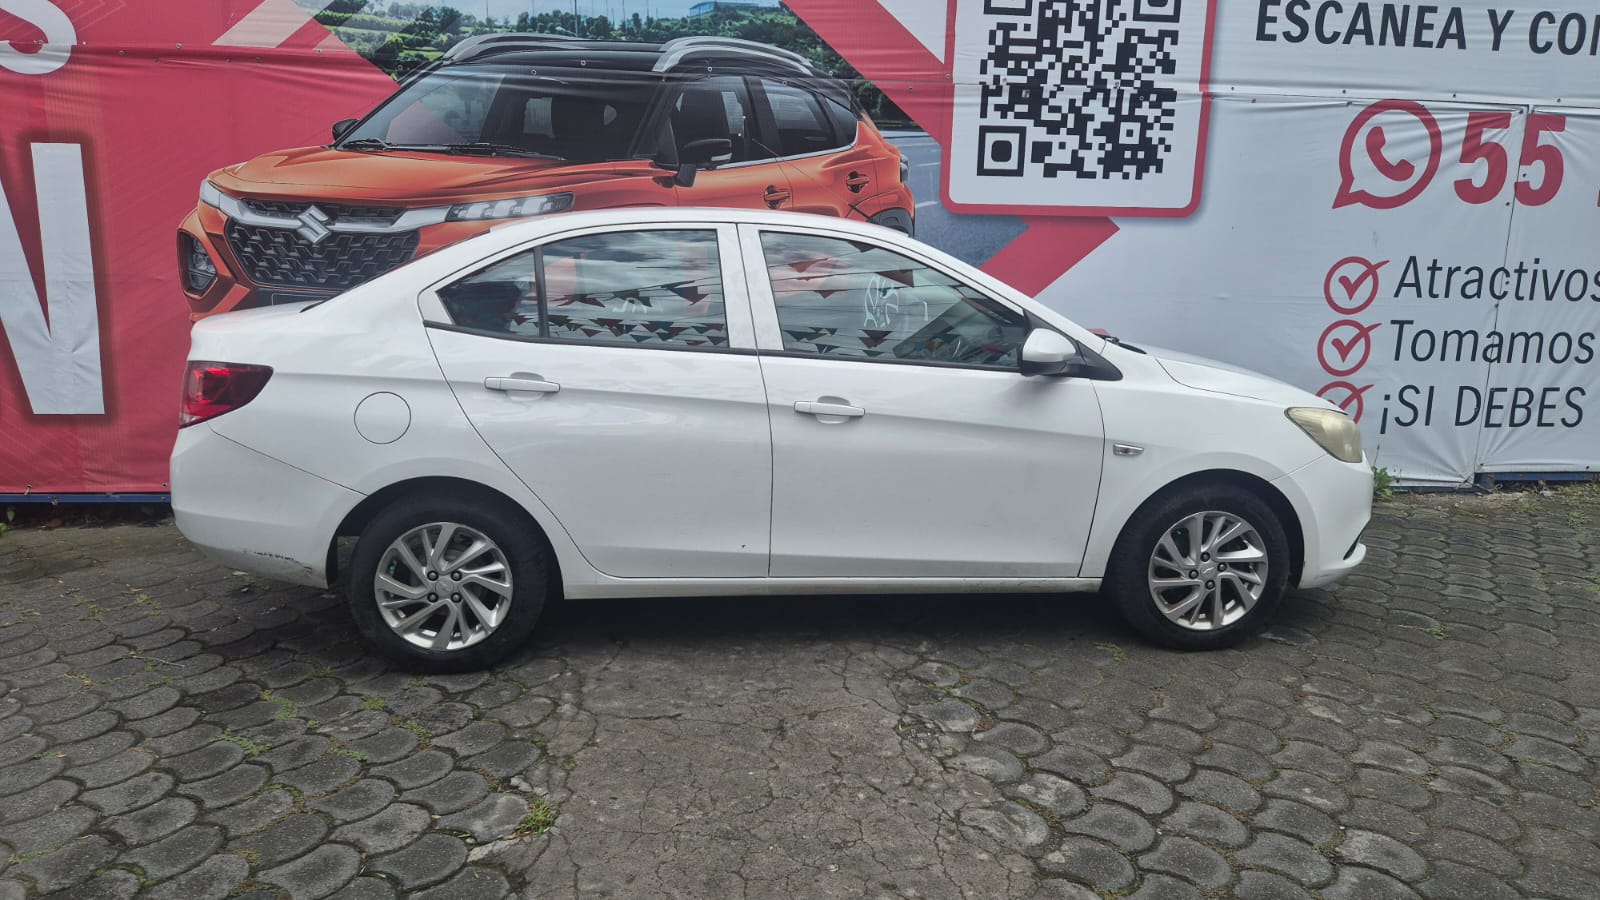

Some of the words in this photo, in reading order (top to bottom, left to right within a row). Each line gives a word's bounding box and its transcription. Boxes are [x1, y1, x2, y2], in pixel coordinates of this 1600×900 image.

[1256, 0, 1467, 50] ESCANEA
[1487, 8, 1515, 51] Y
[1453, 111, 1567, 207] 55
[1390, 319, 1596, 365] Tomamos
[1379, 384, 1435, 435] ¡SI
[1454, 385, 1587, 429] DEBES
